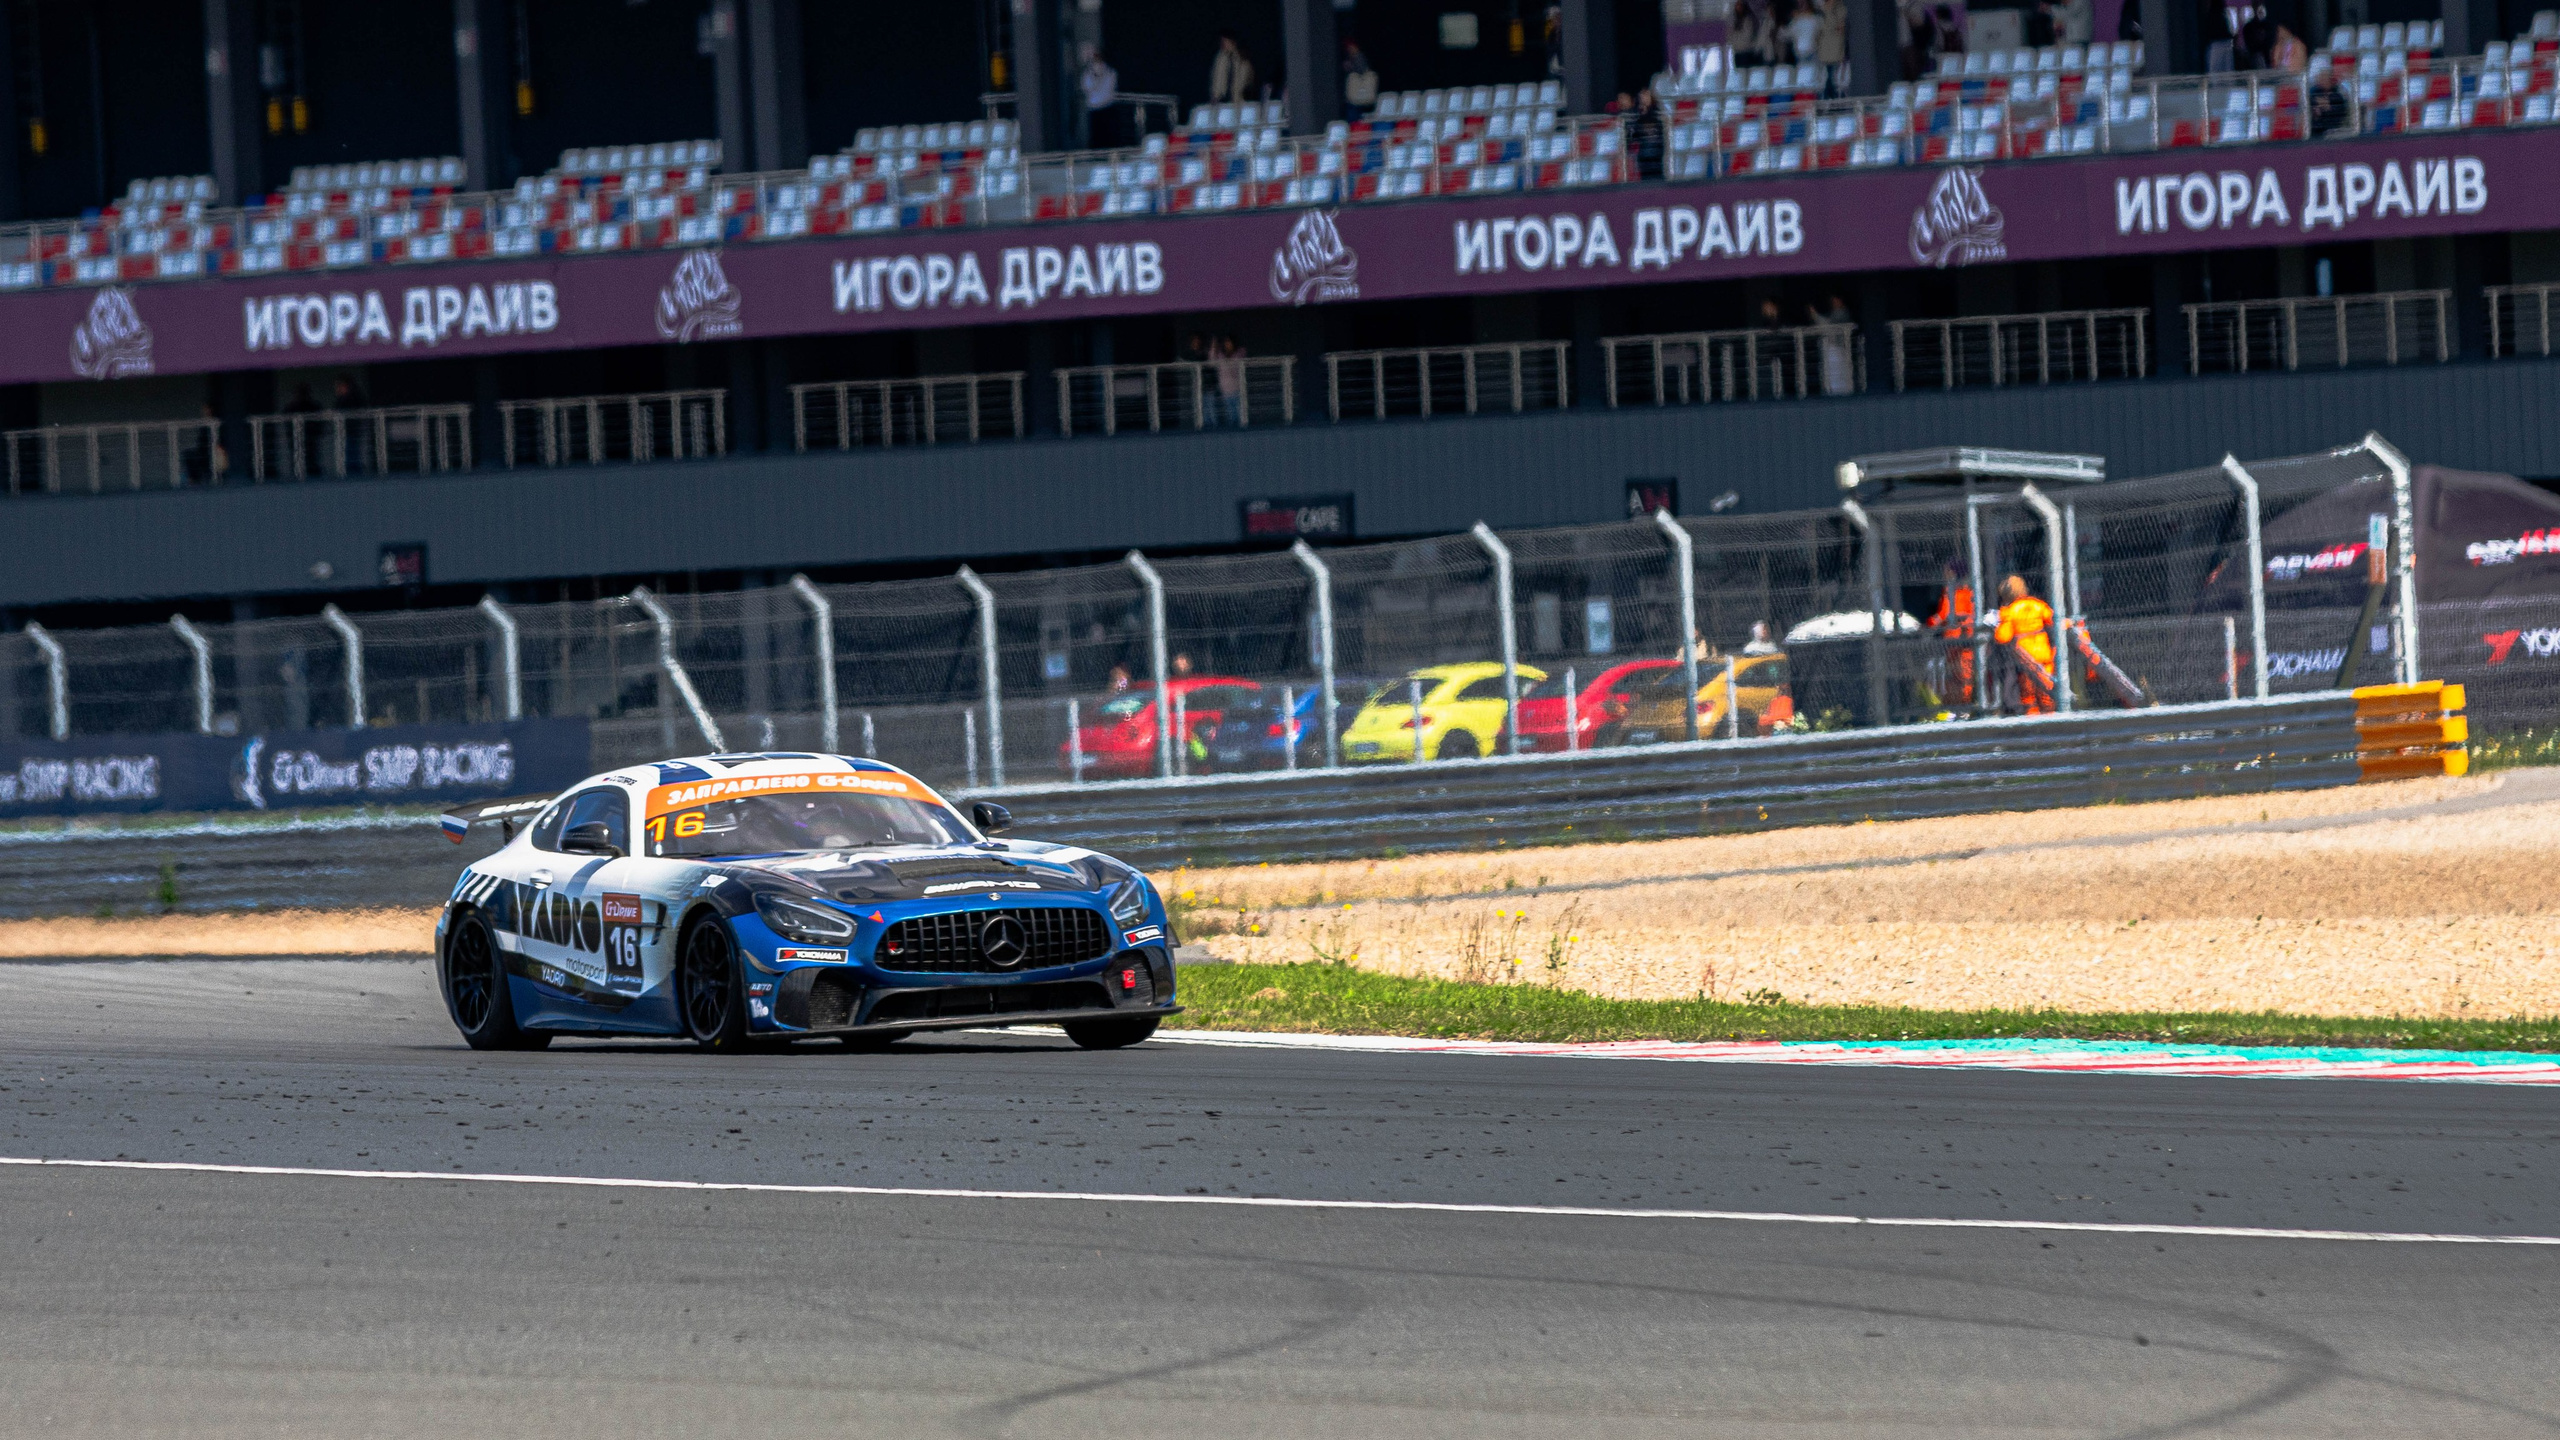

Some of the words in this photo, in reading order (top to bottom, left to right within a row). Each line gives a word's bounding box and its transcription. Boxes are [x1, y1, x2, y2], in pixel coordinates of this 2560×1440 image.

[2115, 170, 2291, 233] ИГОРА
[2302, 157, 2489, 229] ДРАЙВ
[1455, 215, 1621, 273] ИГОРА
[1630, 199, 1804, 270] ДРАЙВ
[833, 252, 990, 311] ИГОРА
[999, 241, 1164, 308] ДРАЙВ
[245, 293, 392, 349] ИГОРА
[401, 280, 559, 346] ДРАЙВ
[666, 774, 810, 806] ЗАПРАВЛЕНО
[645, 811, 707, 844] 16
[609, 926, 638, 968] 16
[541, 964, 567, 988] YADRO
